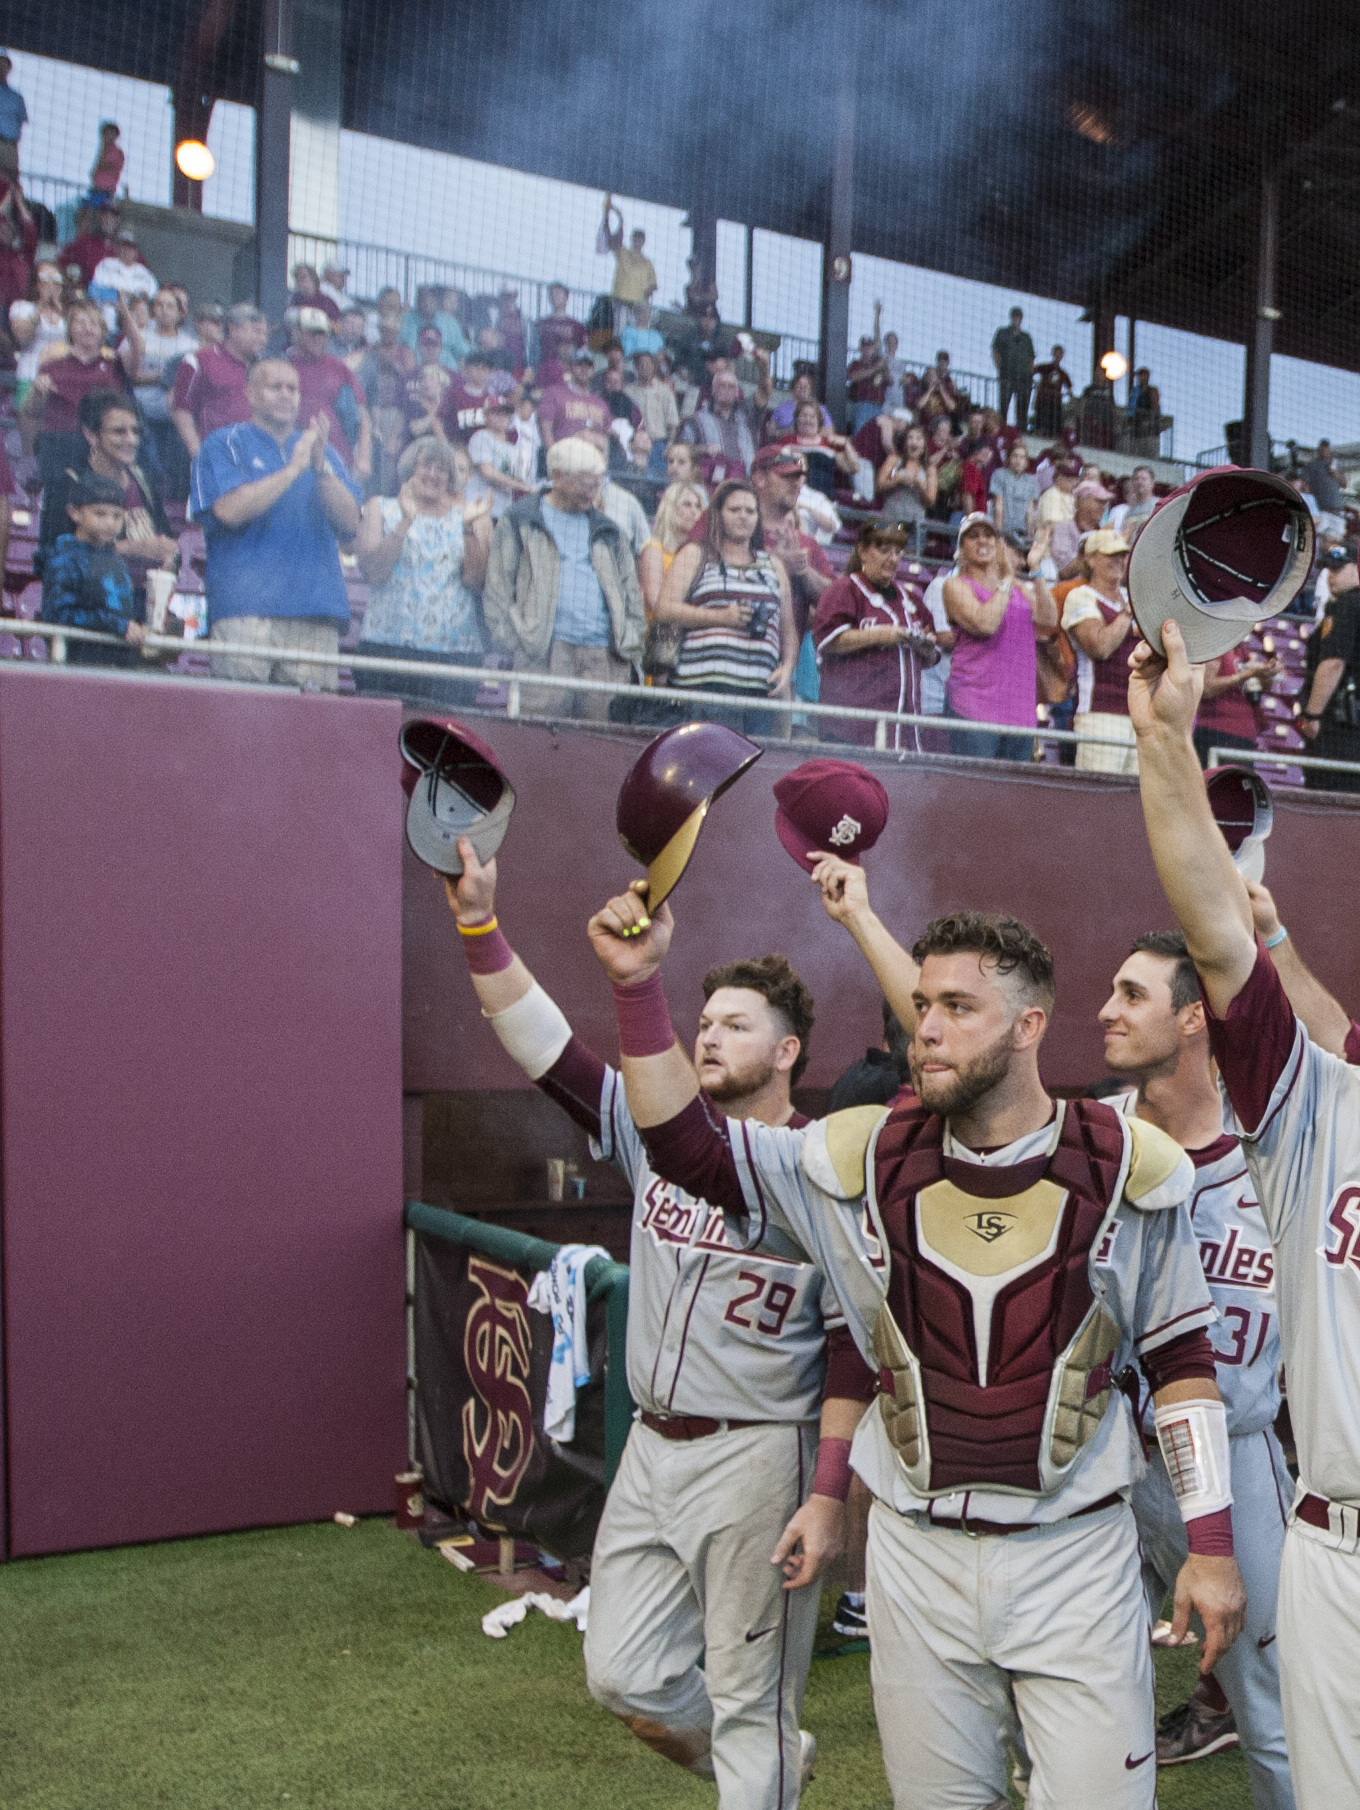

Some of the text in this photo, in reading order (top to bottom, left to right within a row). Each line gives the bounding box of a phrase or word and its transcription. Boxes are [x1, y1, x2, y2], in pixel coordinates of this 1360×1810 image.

[637, 1176, 730, 1246] Semin
[1198, 1223, 1276, 1290] oles
[723, 1270, 798, 1337] 29
[1213, 1305, 1272, 1369] 31
